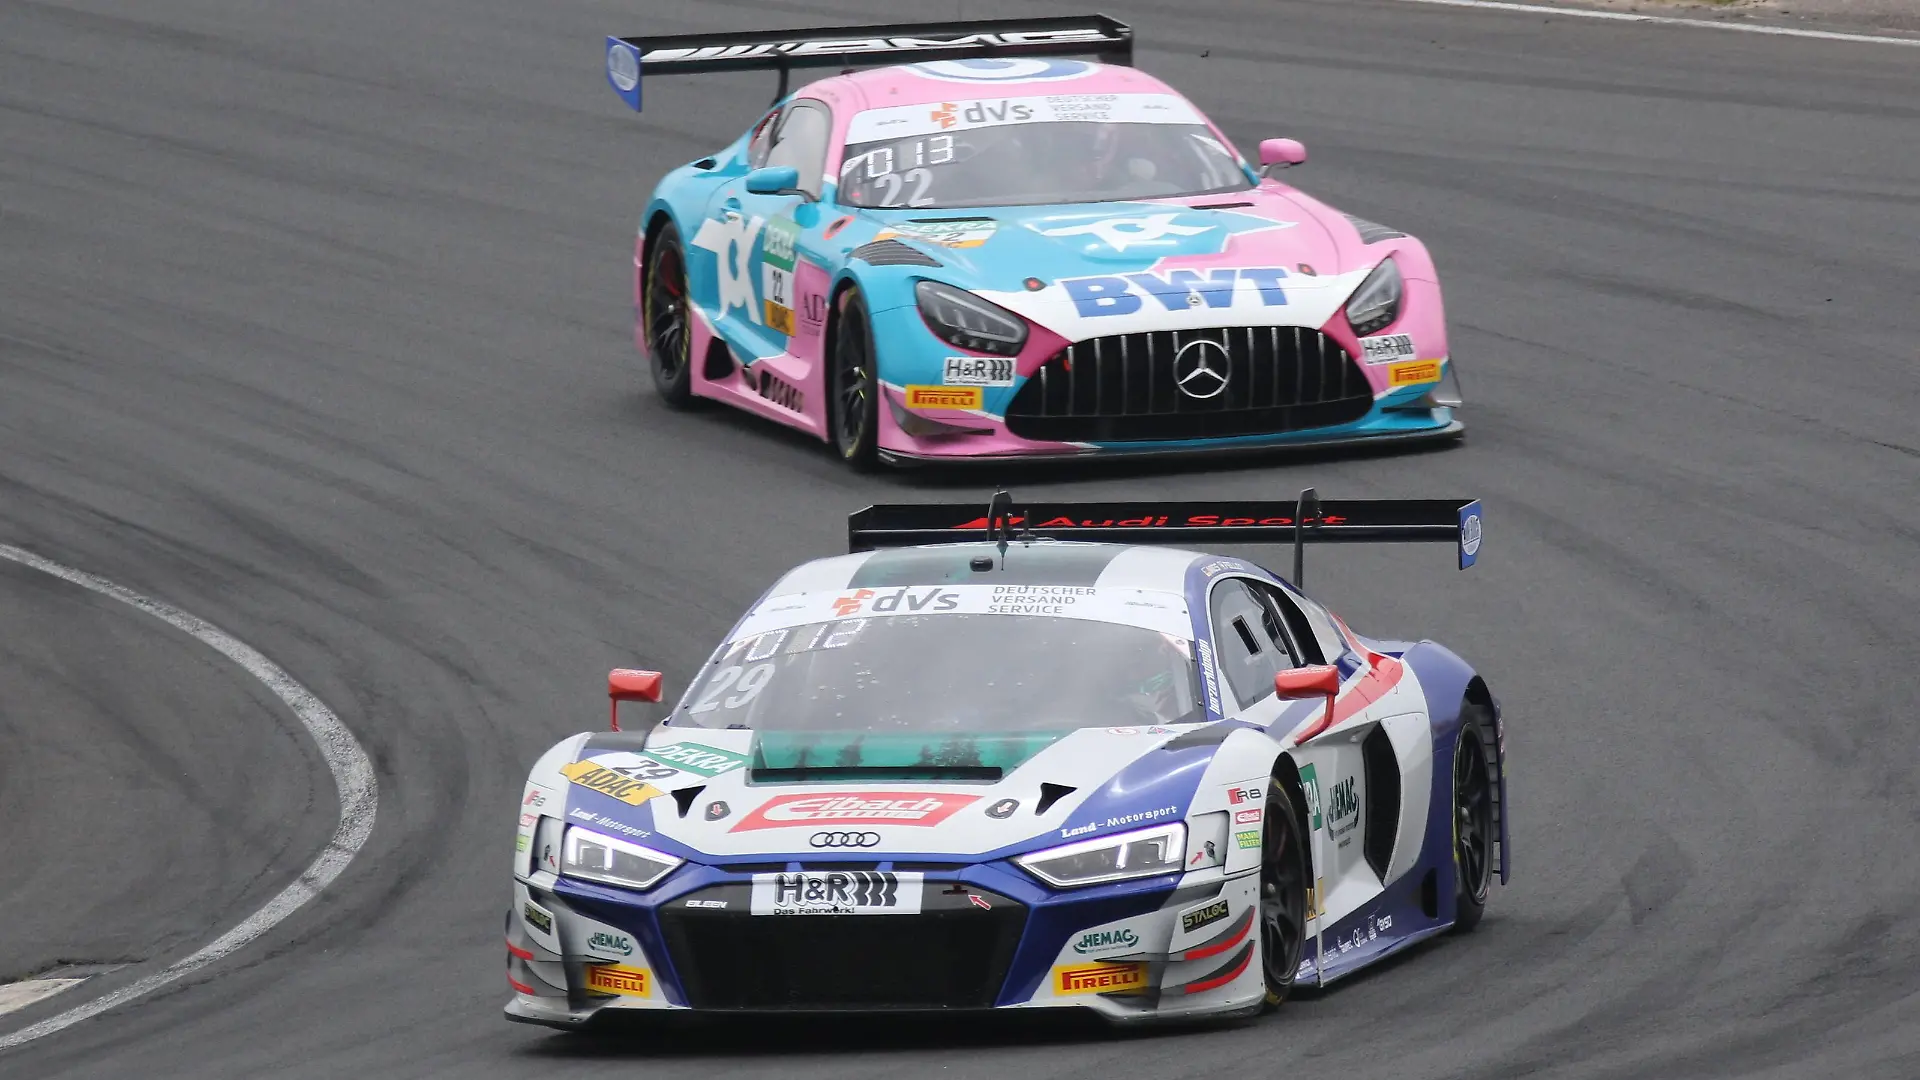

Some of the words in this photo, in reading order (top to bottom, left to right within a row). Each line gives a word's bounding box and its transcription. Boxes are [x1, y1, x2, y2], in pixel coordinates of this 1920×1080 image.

[786, 30, 1122, 55] AMG
[874, 168, 935, 207] 22
[773, 270, 784, 305] 22
[1060, 268, 1288, 318] BWT
[948, 359, 987, 378] H&R
[912, 390, 976, 405] PIRELLI
[1035, 516, 1169, 528] Audi
[1184, 515, 1347, 527] Sport
[991, 595, 1077, 606] VERSAND
[994, 586, 1097, 597] DEUTSCHER
[987, 604, 1064, 615] SERVICE
[690, 663, 776, 715] 29
[611, 759, 680, 780] 29
[650, 746, 744, 774] DEKRA
[575, 768, 645, 798] ADAC
[1236, 788, 1262, 802] R8
[762, 796, 943, 822] Eibach
[774, 873, 856, 907] H&R
[774, 907, 796, 916] Das
[798, 907, 856, 916] Fahrwerk!
[1184, 902, 1228, 928] STALOC
[1079, 929, 1136, 948] HEMAC
[590, 966, 645, 992] PIRELLI
[1061, 963, 1139, 991] PIRELLI
